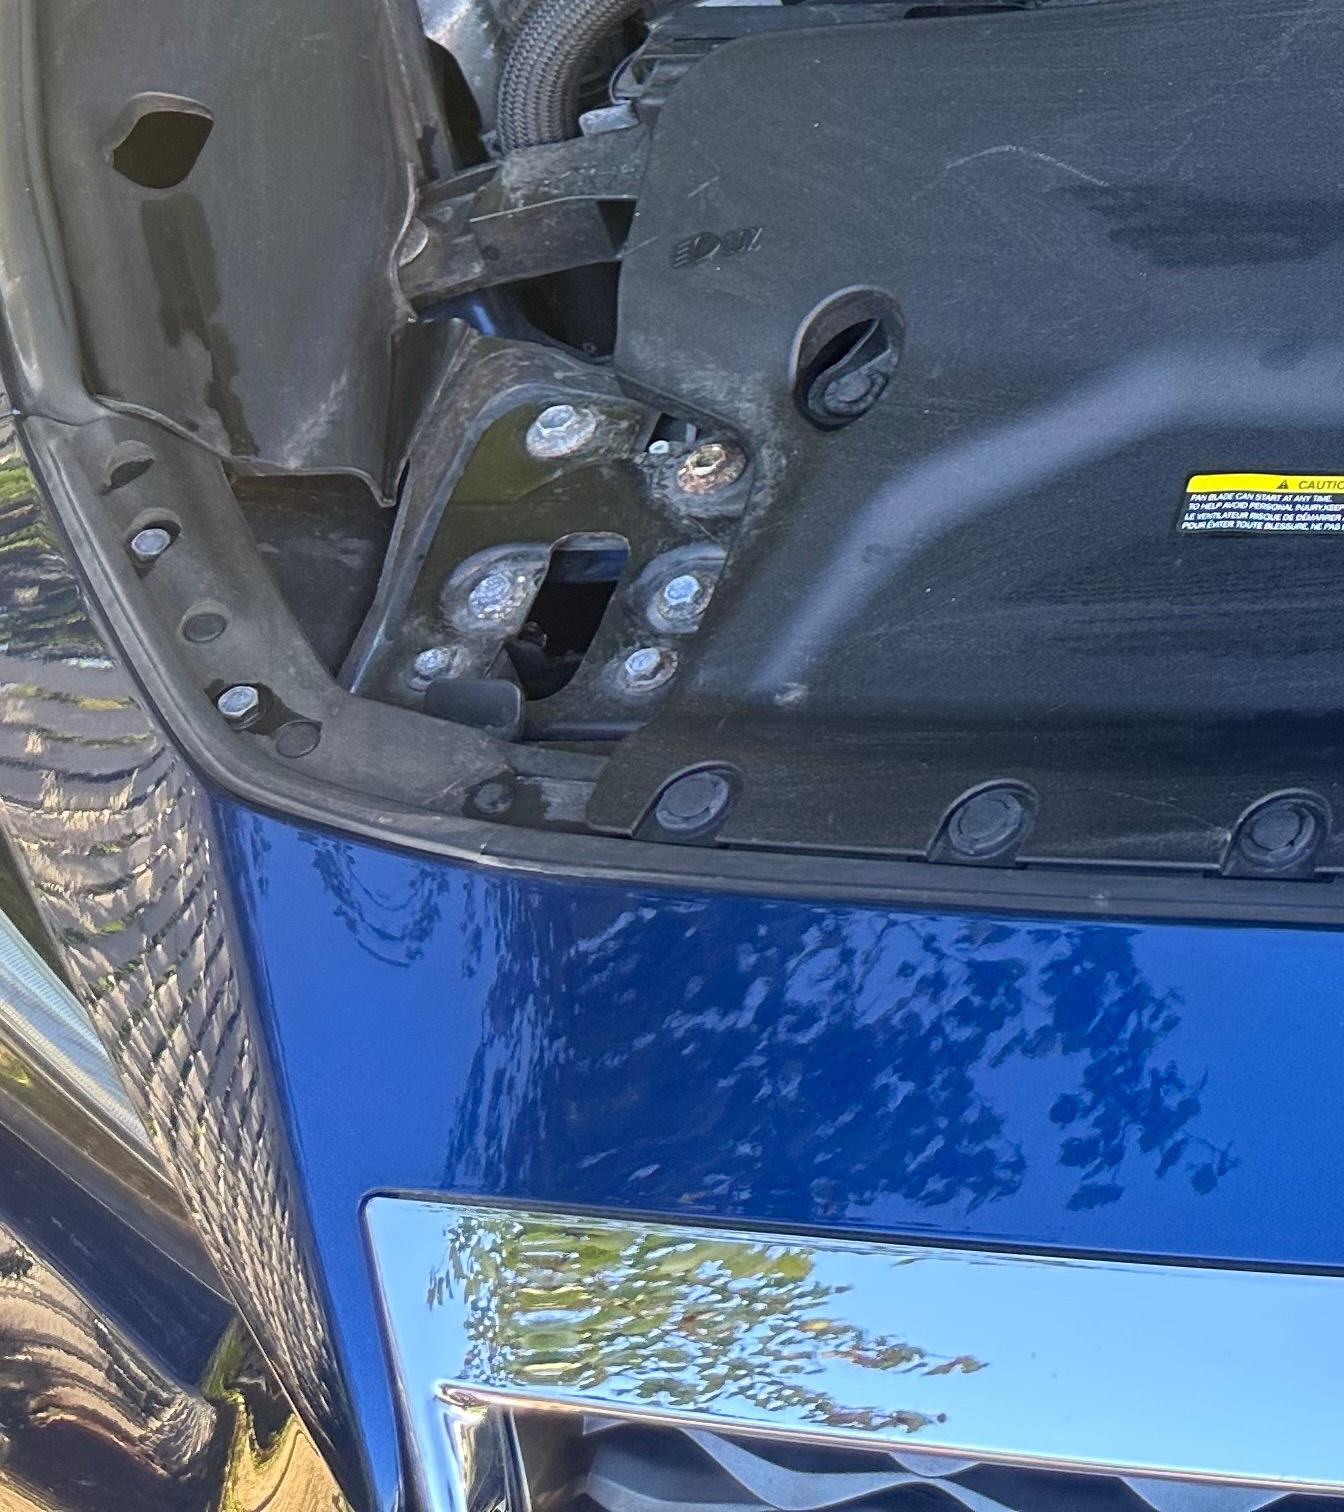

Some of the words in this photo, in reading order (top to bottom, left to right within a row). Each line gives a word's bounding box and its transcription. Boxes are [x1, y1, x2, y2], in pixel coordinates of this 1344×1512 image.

[1208, 493, 1235, 501] BLADE
[1235, 492, 1254, 500] CAN
[1255, 493, 1281, 501] START
[1281, 494, 1294, 502] AT
[1189, 502, 1201, 510] TO
[1201, 502, 1222, 510] HELP
[1221, 501, 1248, 509] AVOID
[1249, 502, 1294, 511] PERSONAL
[1196, 511, 1249, 520] VENTILATEUR
[1249, 512, 1282, 521] RISQUE
[1282, 513, 1294, 521] DE
[1181, 521, 1206, 529] POUR
[1235, 521, 1264, 529] TOUTE
[1323, 522, 1341, 530] PAS
